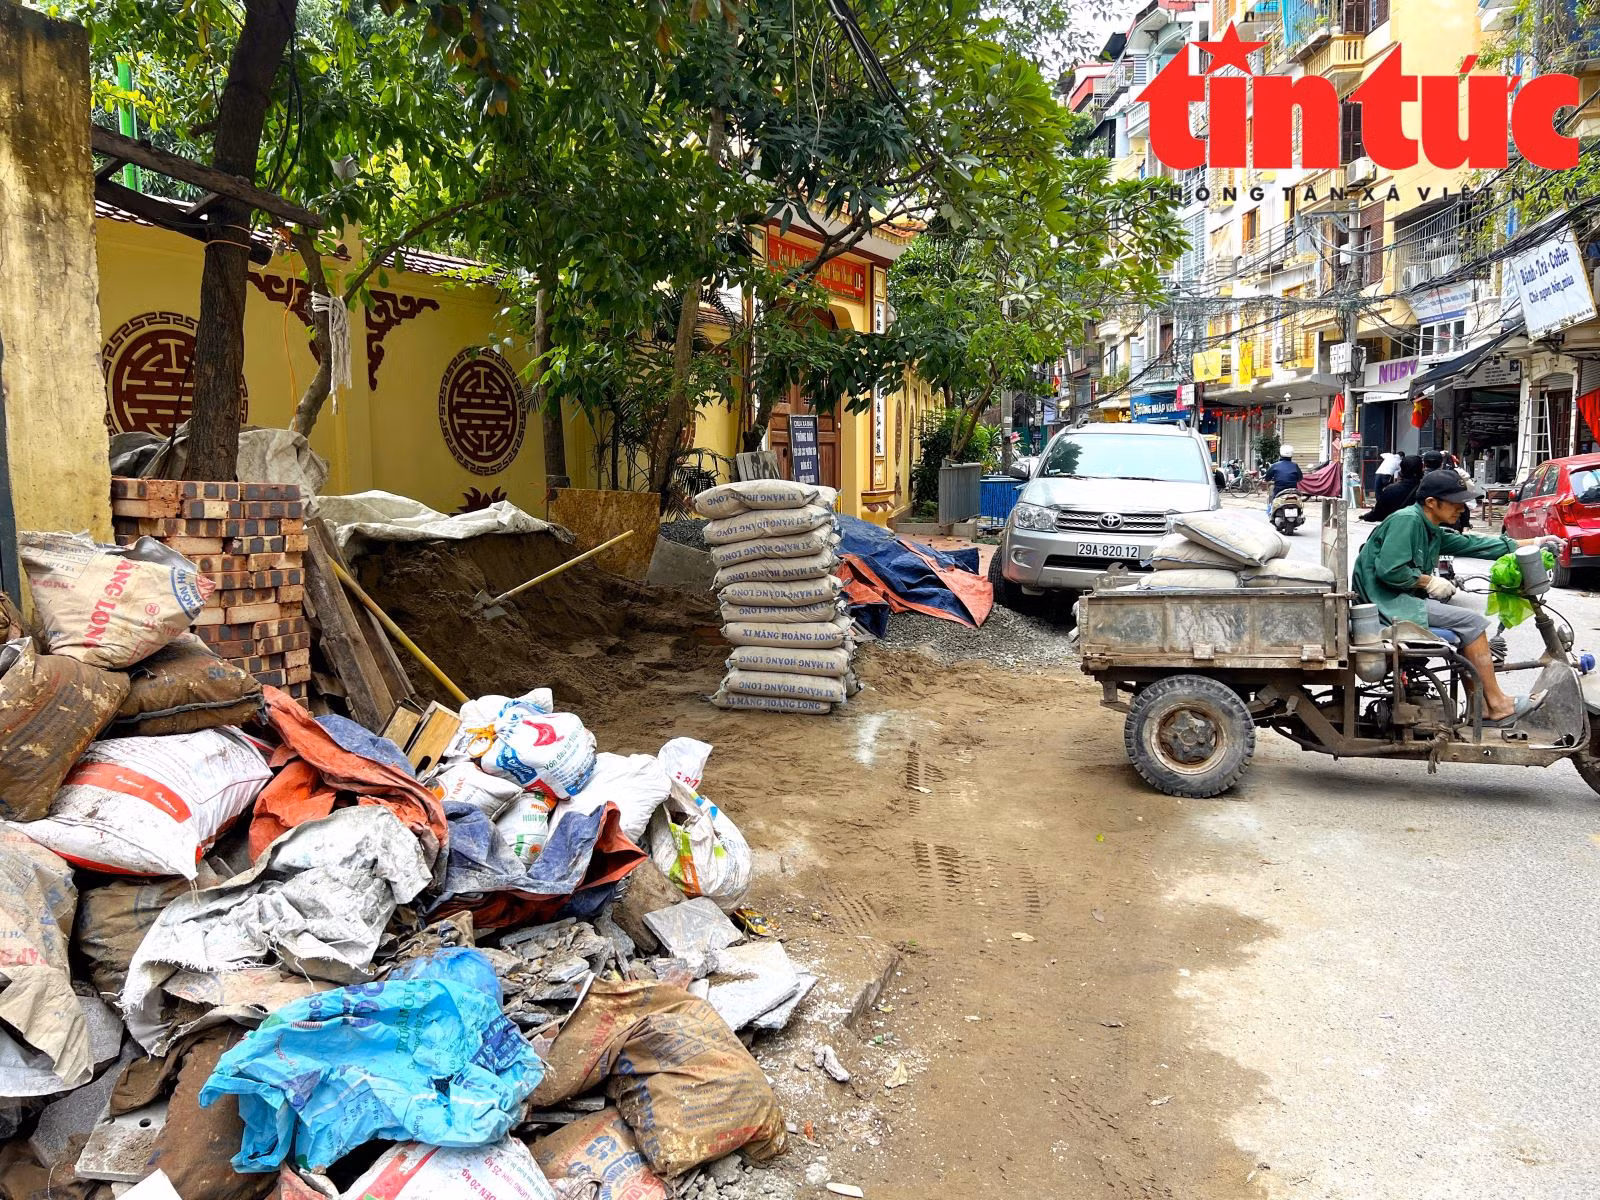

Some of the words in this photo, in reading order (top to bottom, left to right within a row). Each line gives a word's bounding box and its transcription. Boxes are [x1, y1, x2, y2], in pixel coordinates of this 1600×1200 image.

[1079, 544, 1138, 557] 29A-820.12
[720, 550, 742, 562] LONG
[742, 629, 752, 637] XI
[739, 681, 762, 689] LONG
[797, 701, 821, 710] LONG
[484, 1156, 495, 1169] kg
[492, 1165, 502, 1175] 25
[470, 1179, 481, 1190] 20
